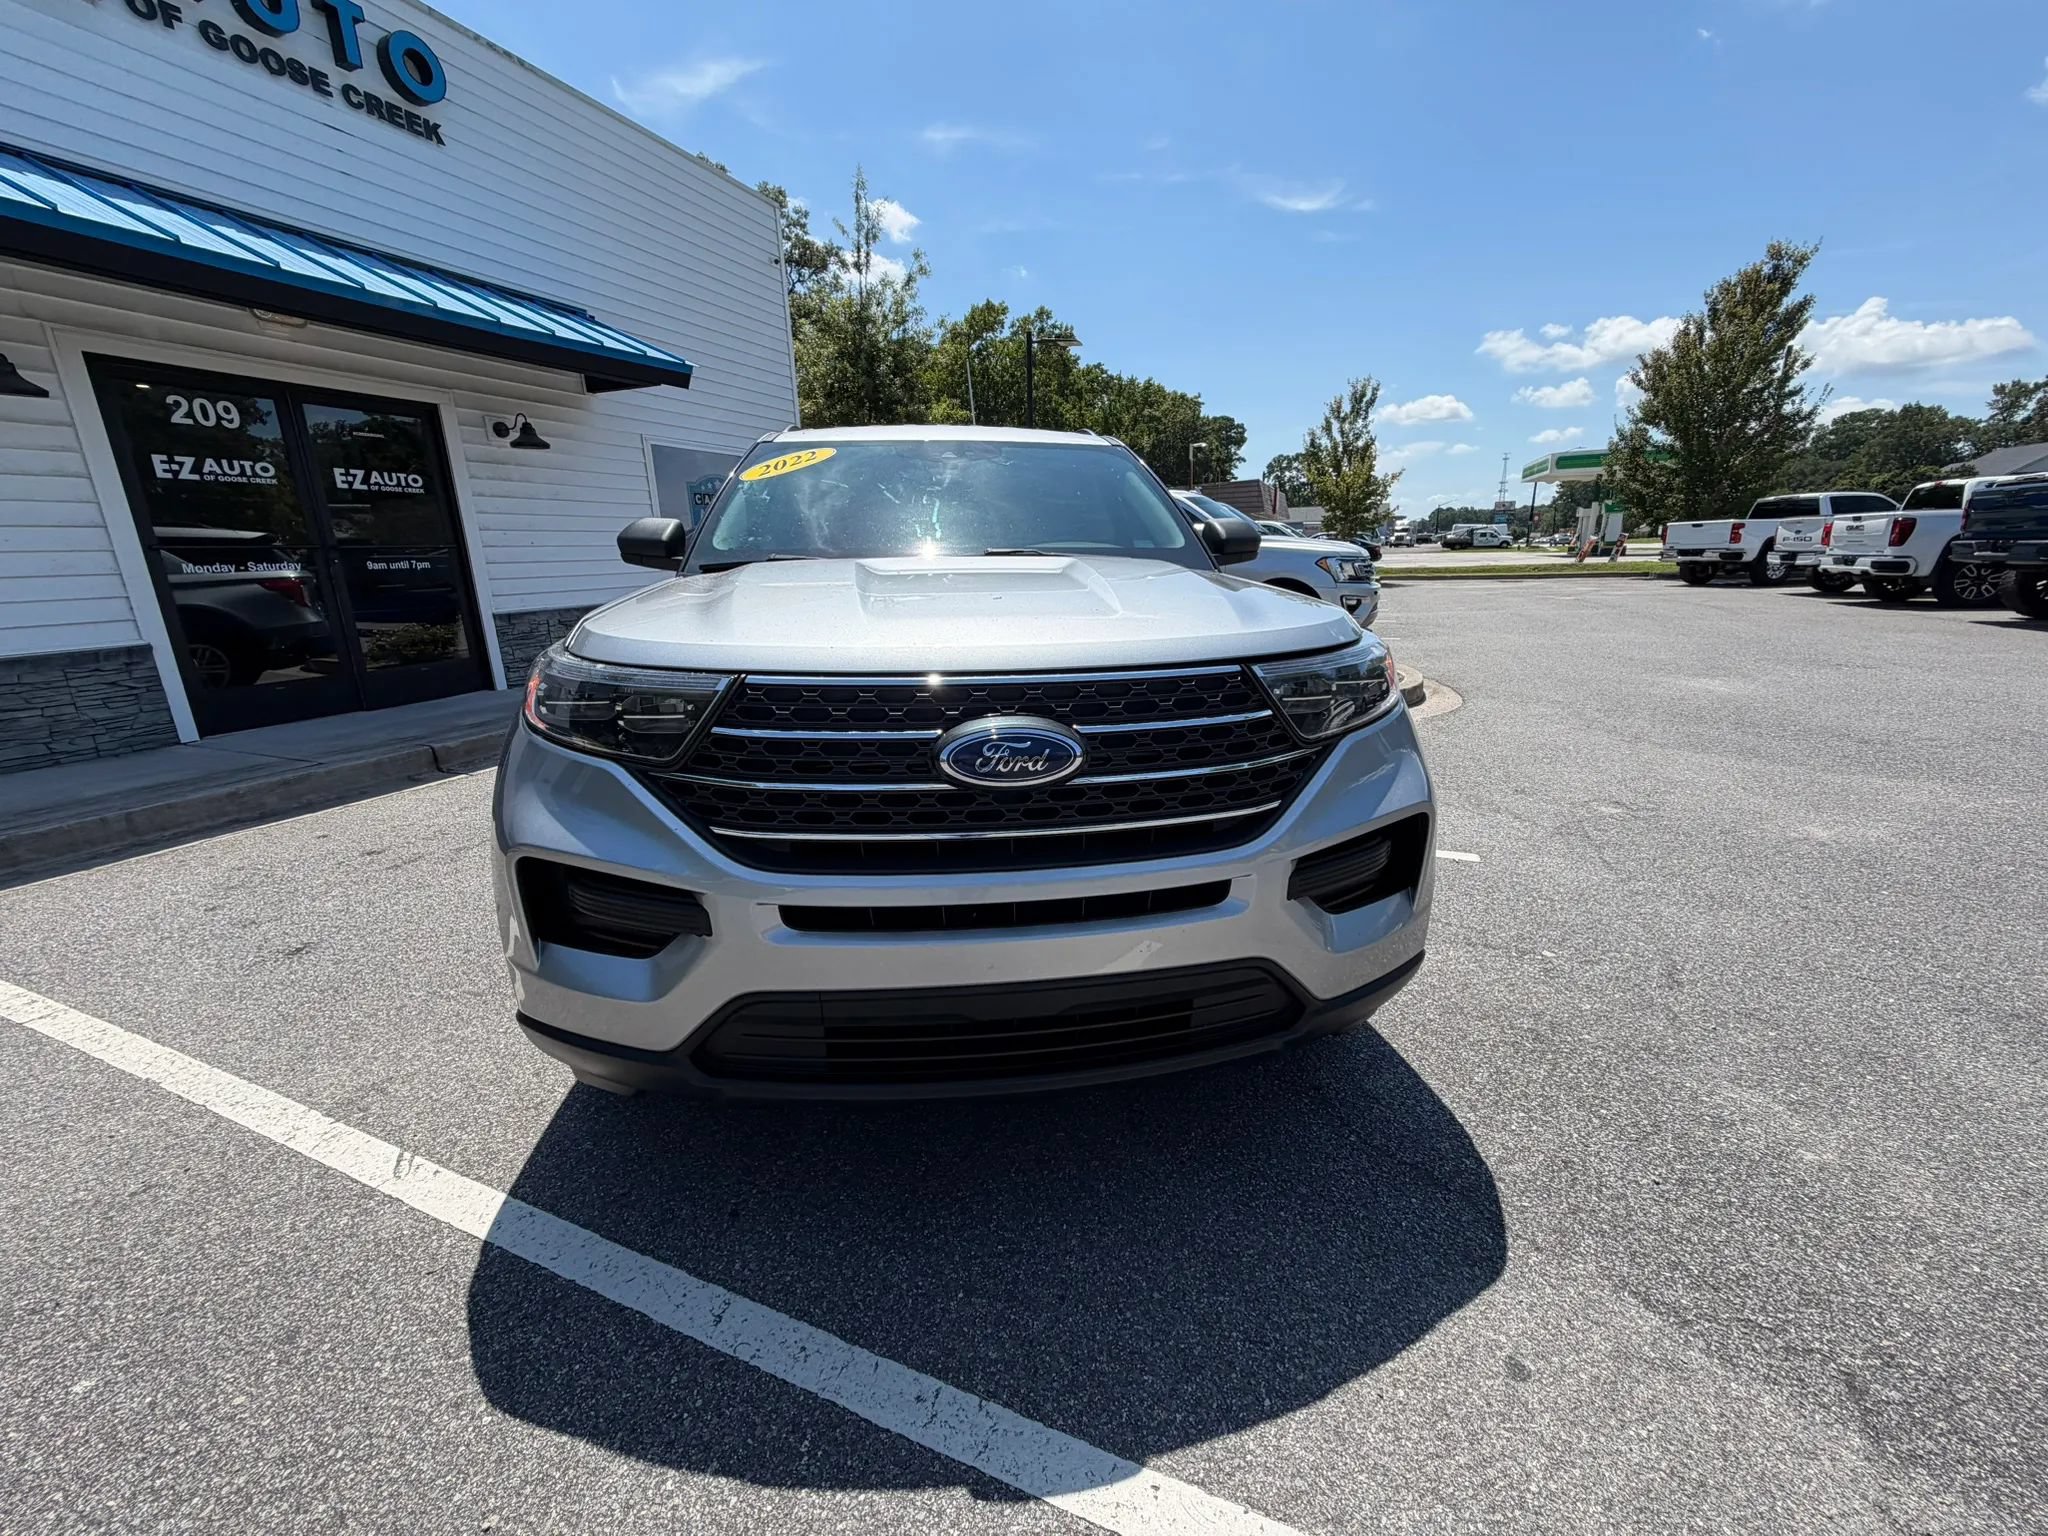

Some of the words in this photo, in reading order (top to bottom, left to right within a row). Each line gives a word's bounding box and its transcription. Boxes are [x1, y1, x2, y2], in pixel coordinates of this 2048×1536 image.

[193, 0, 446, 106] TO
[124, 0, 183, 30] OF
[198, 19, 333, 98] GOOSE
[341, 83, 446, 146] CREEK
[165, 394, 240, 429] 209
[150, 453, 200, 480] E-Z
[202, 458, 275, 477] AUTO
[758, 450, 817, 477] 2022
[217, 475, 248, 483] GOOSE
[249, 477, 279, 485] CREEK
[333, 467, 369, 490] E-Z
[369, 470, 423, 488] AUTO
[380, 485, 403, 493] GOOSE
[694, 493, 716, 505] CA
[181, 562, 236, 574] Monday
[247, 561, 301, 573] Saturday
[366, 560, 388, 570] 9am
[389, 559, 410, 569] until
[410, 560, 431, 571] 7pm
[974, 741, 1051, 773] Ford
